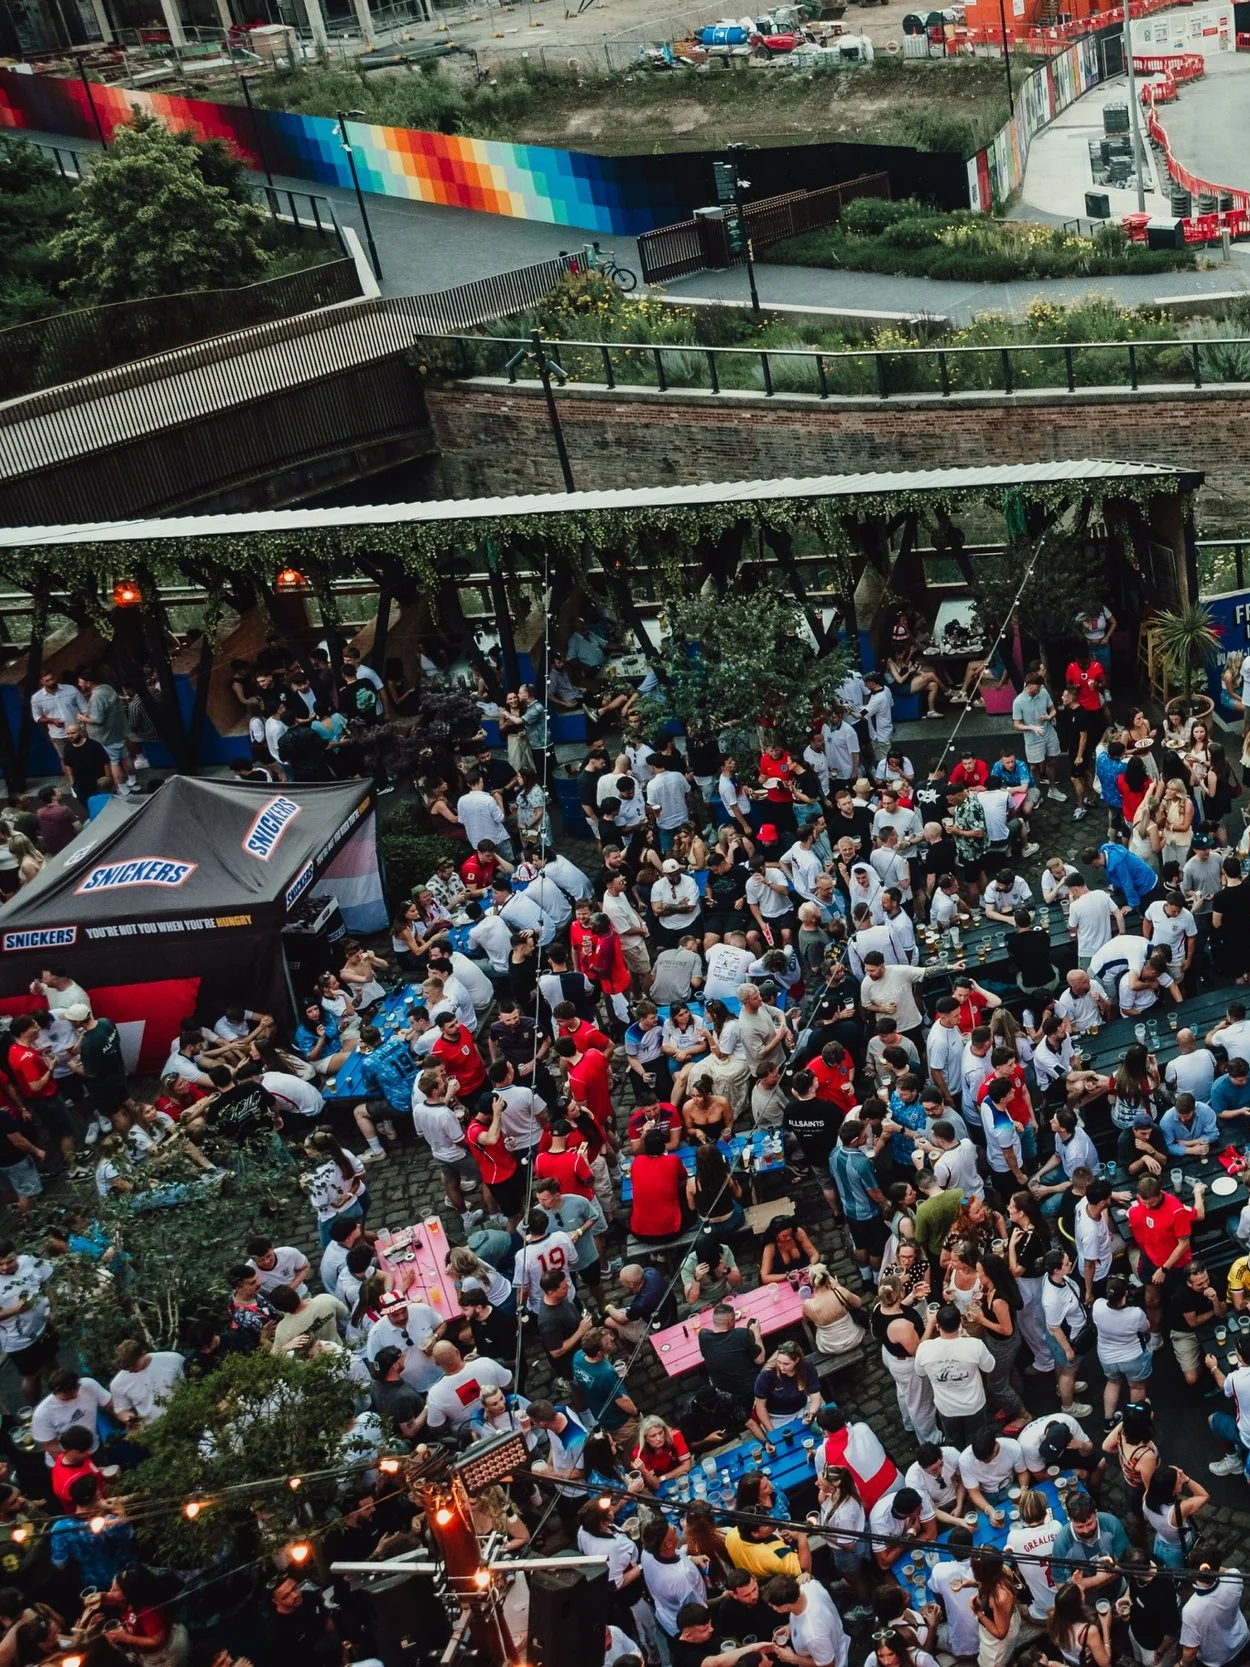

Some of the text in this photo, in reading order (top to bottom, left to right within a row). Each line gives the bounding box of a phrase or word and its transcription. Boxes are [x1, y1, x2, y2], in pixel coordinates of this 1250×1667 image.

[248, 796, 297, 856] SNICKERS
[83, 860, 188, 889] SNICKERS
[5, 914, 252, 949] SNICKERS YOU'RE NOT YOU WHEN YOU'RE HUNGRY
[389, 1049, 417, 1079] 19
[537, 1246, 566, 1273] 19
